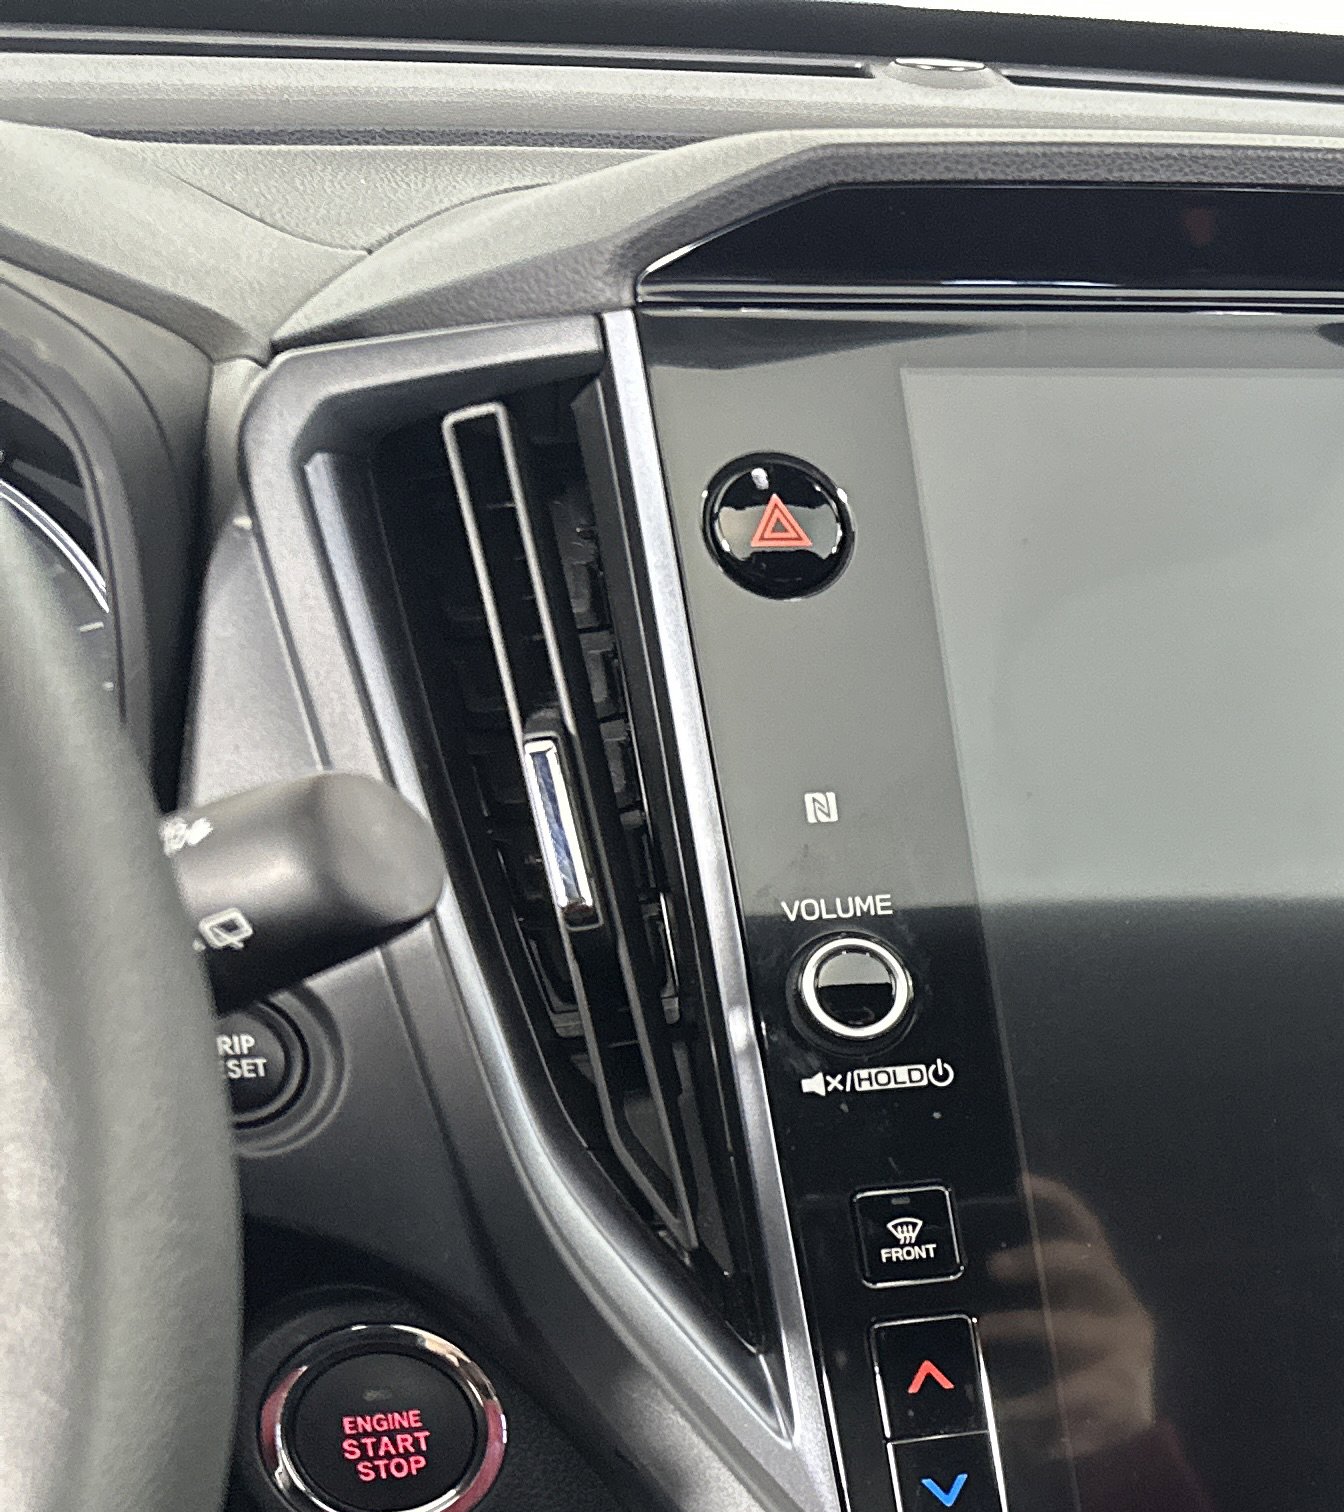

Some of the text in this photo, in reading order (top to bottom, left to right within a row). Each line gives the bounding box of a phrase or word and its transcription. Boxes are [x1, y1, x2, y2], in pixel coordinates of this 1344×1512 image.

[781, 894, 894, 922] VOLUME
[216, 1033, 255, 1056] RIP
[857, 1066, 924, 1088] HOLD
[880, 1242, 937, 1263] FRONT
[343, 1411, 422, 1434] ENGINE
[343, 1431, 431, 1459] START
[356, 1455, 428, 1481] STOP
